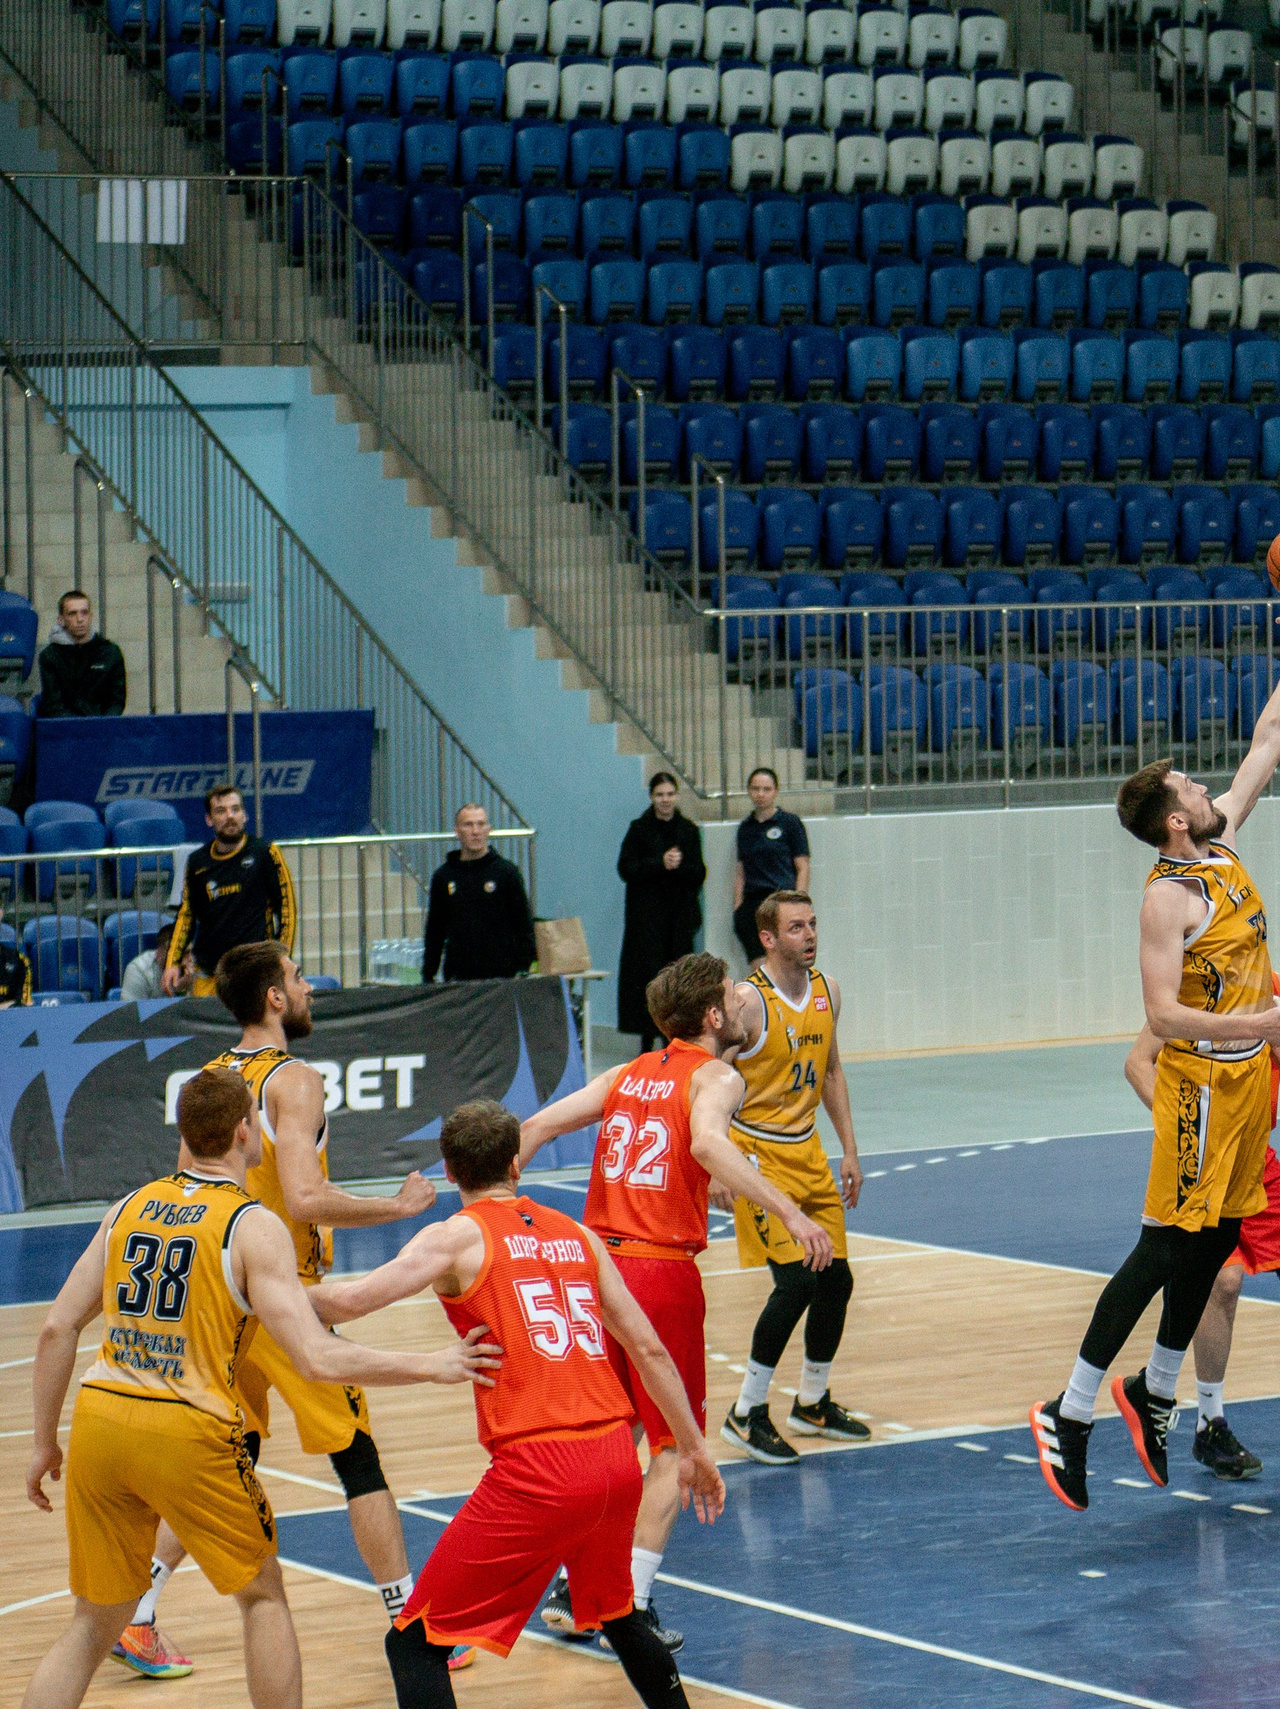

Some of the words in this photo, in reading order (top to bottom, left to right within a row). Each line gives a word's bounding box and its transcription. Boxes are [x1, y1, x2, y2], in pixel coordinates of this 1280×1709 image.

[234, 765, 303, 790] LNE
[791, 1059, 817, 1093] 24
[601, 1110, 671, 1191] 32
[116, 1231, 197, 1322] 38
[503, 1234, 586, 1264] ШИРУНОВ
[512, 1276, 608, 1362] 55
